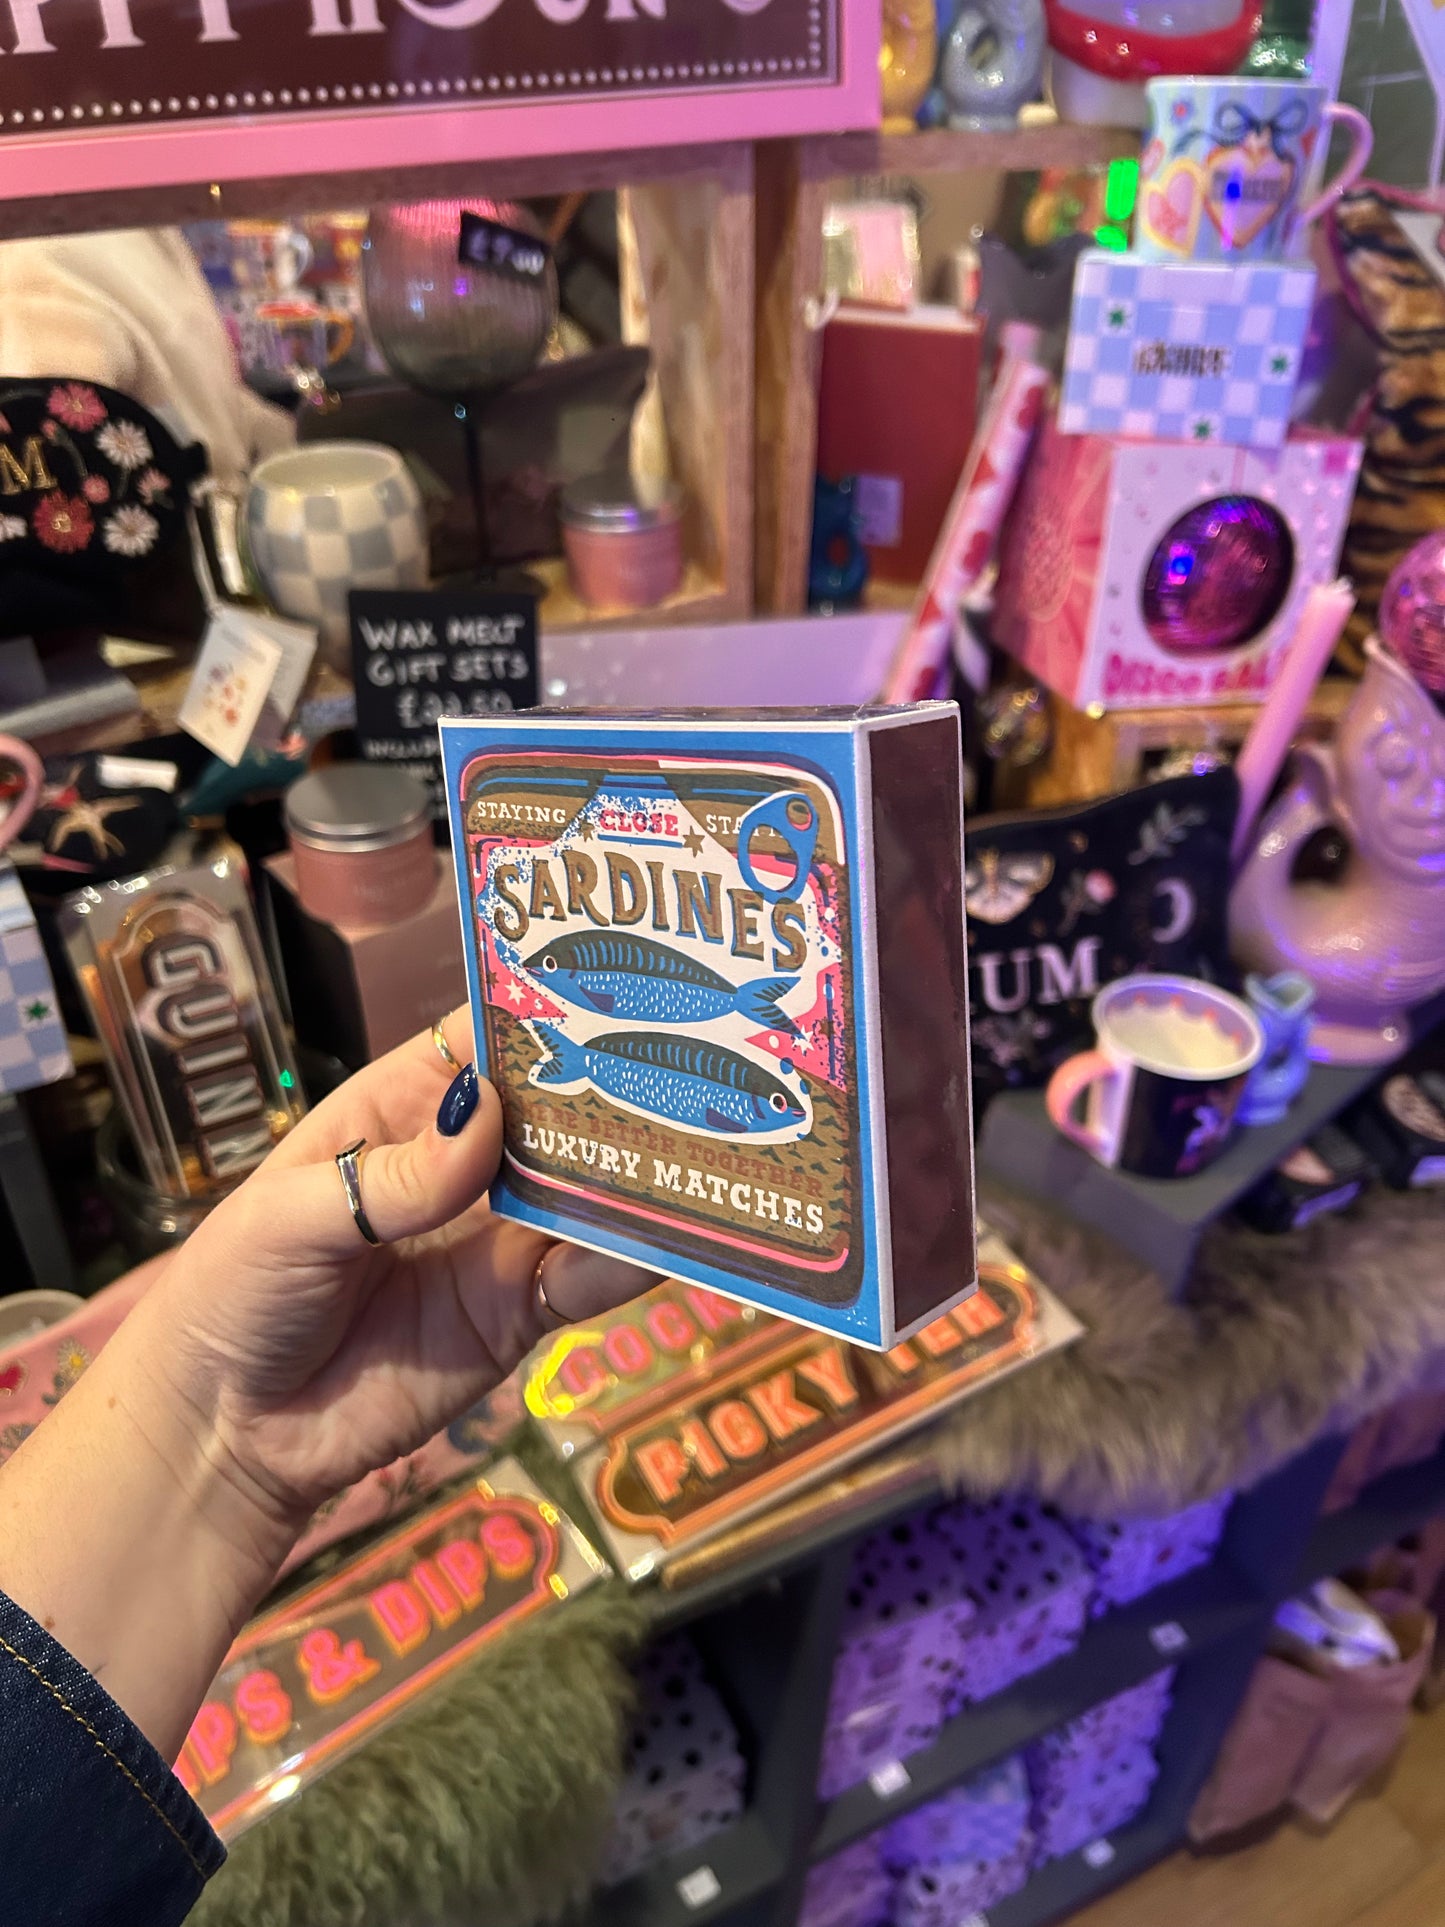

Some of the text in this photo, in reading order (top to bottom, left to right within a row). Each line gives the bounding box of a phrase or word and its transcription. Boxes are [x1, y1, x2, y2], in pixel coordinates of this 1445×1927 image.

[358, 613, 526, 650] WAX MELT
[366, 650, 530, 687] GIFT SETS
[477, 801, 567, 824] STAYING
[599, 808, 680, 837] CLOSE
[493, 849, 808, 973] SARDINES
[523, 1123, 825, 1234] LUXURY MATCHES
[589, 1117, 678, 1156] BETTER
[686, 1140, 824, 1198] TOGETHER
[634, 1347, 859, 1504] PICKY
[298, 1627, 382, 1705] &
[369, 1514, 536, 1658] DIPS
